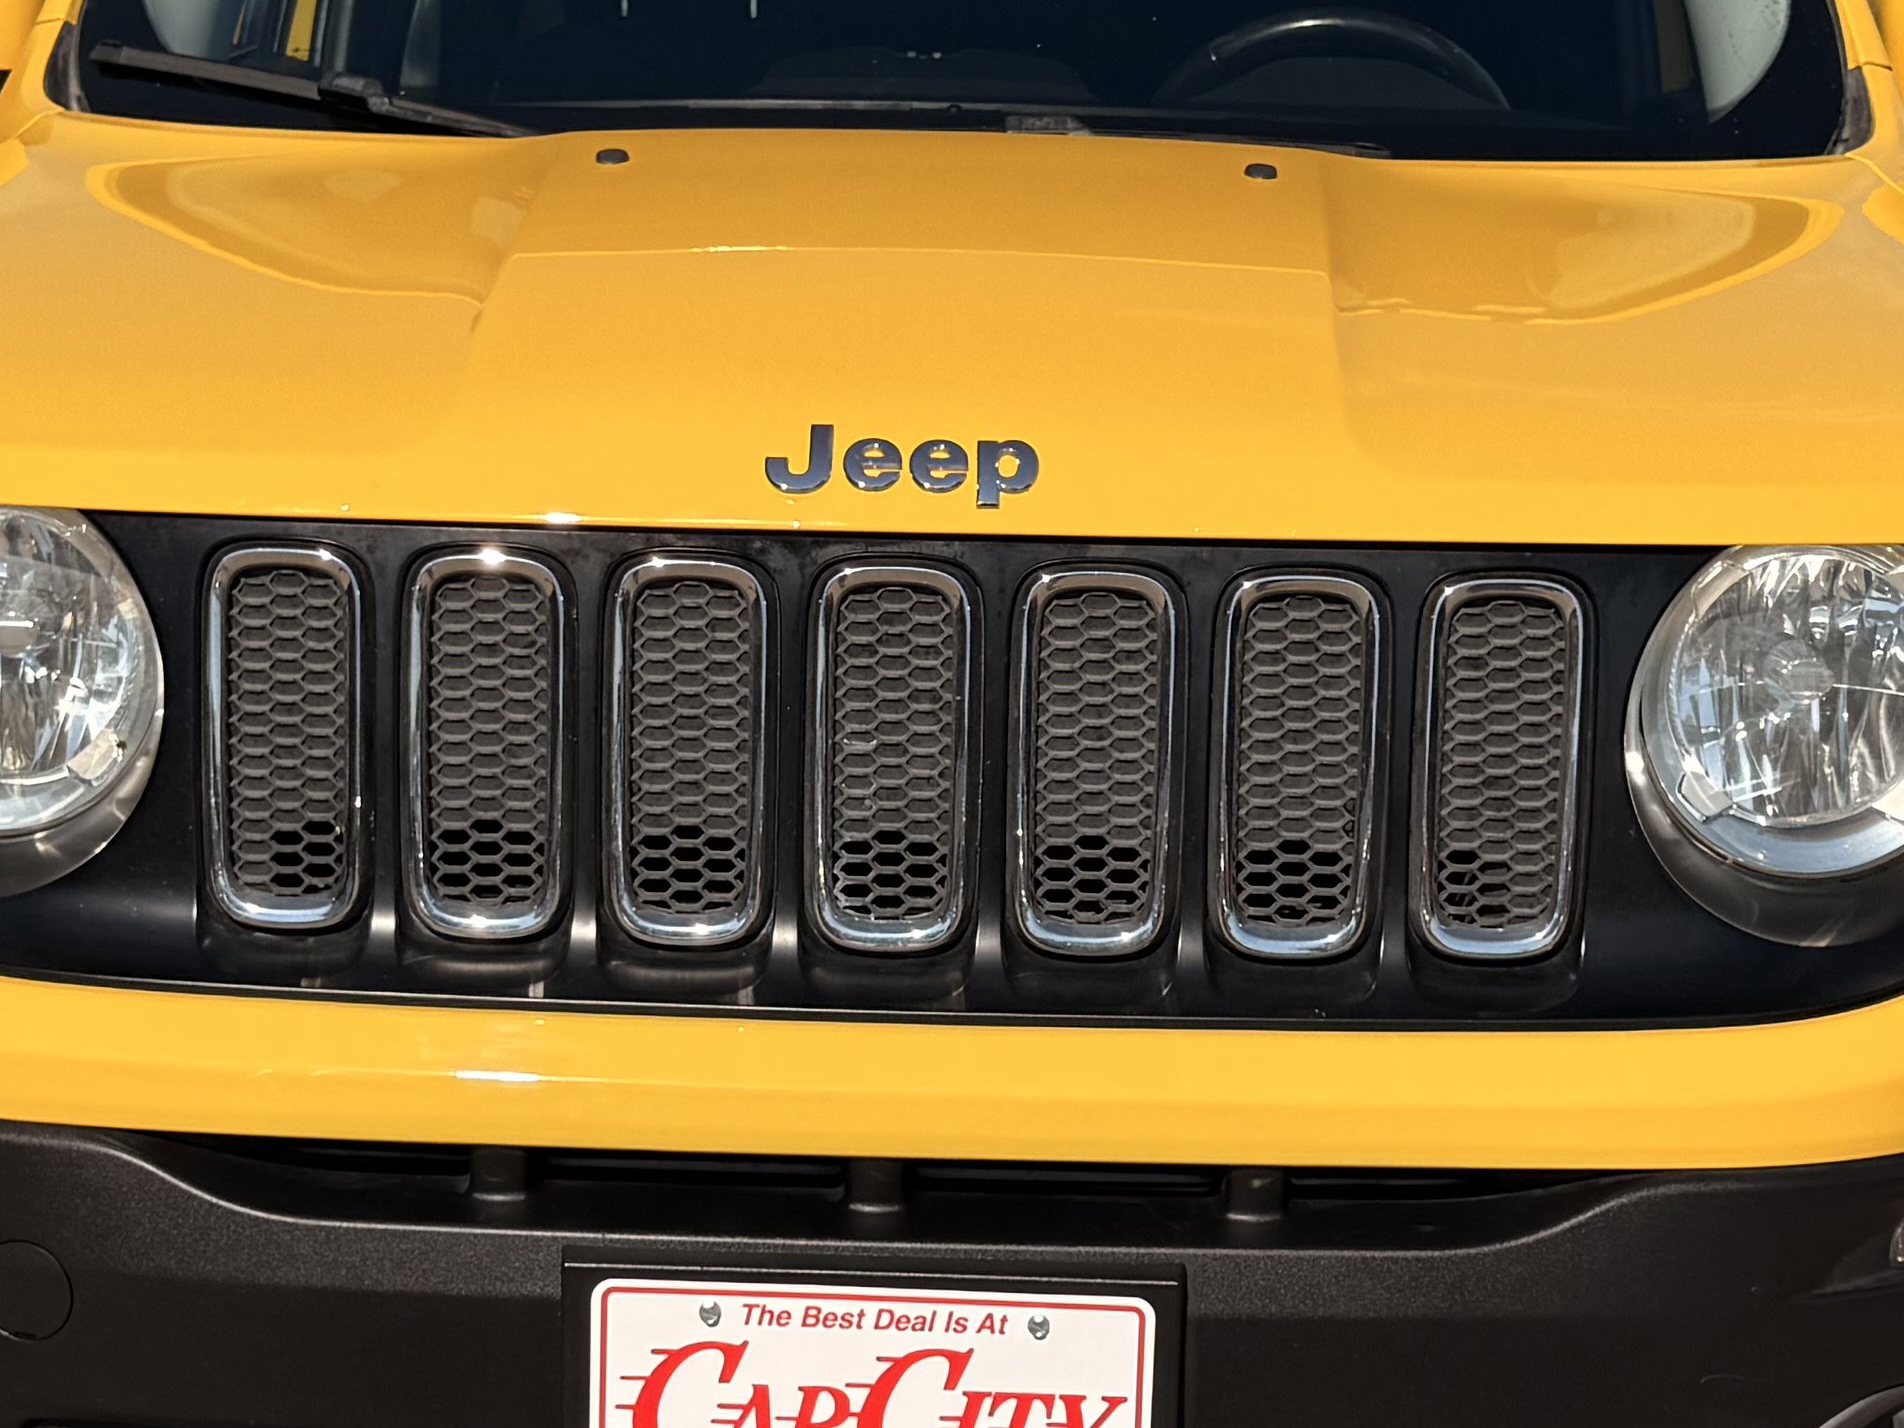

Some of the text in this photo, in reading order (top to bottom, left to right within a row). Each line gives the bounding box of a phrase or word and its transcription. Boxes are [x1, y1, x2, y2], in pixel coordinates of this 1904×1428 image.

[764, 423, 1040, 509] Jeep
[742, 1304, 1008, 1335] The Best Deal Is At
